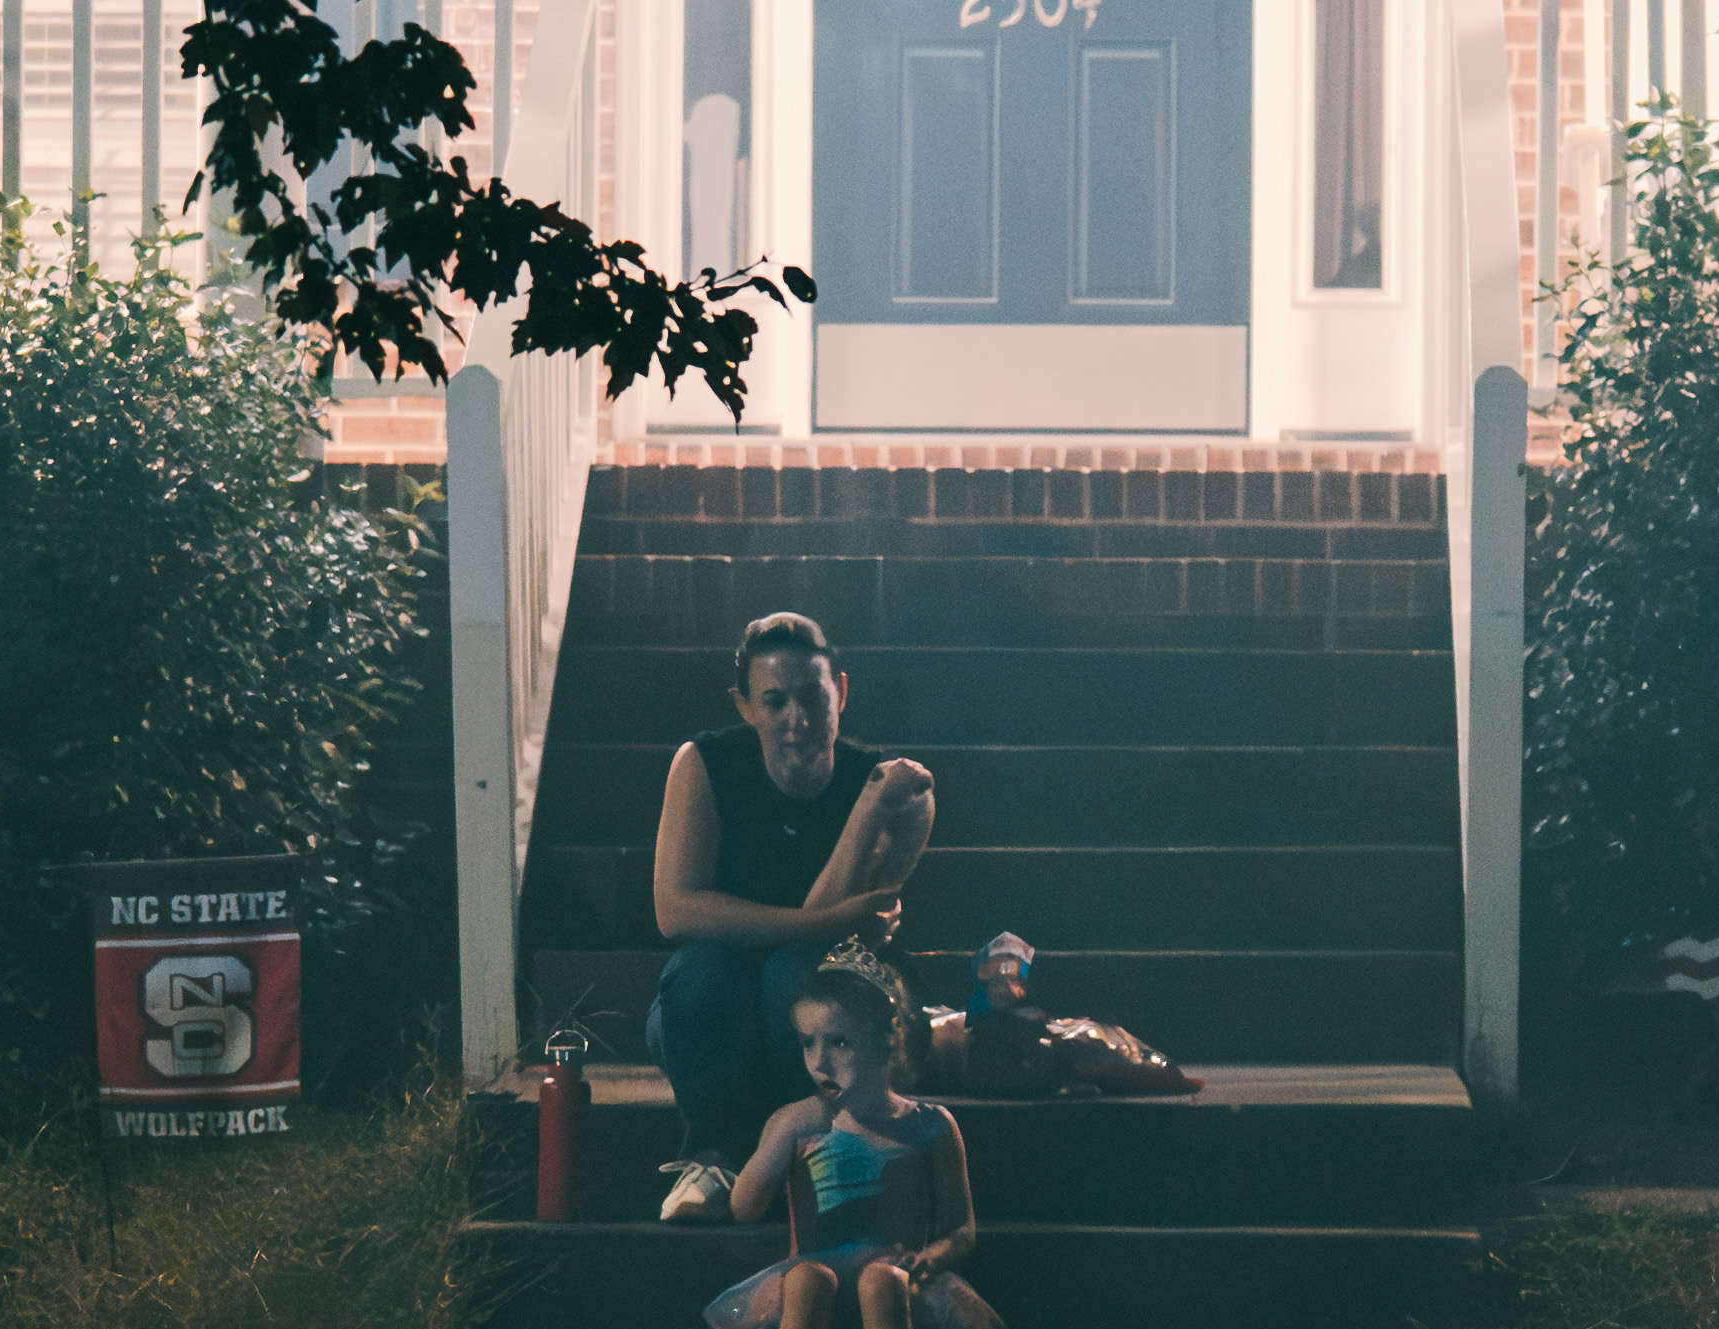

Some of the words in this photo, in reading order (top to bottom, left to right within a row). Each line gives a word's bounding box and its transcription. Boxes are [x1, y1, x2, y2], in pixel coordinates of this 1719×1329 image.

[111, 895, 159, 925] NC
[170, 890, 287, 923] STATE
[116, 1106, 290, 1137] WOLFPACK
